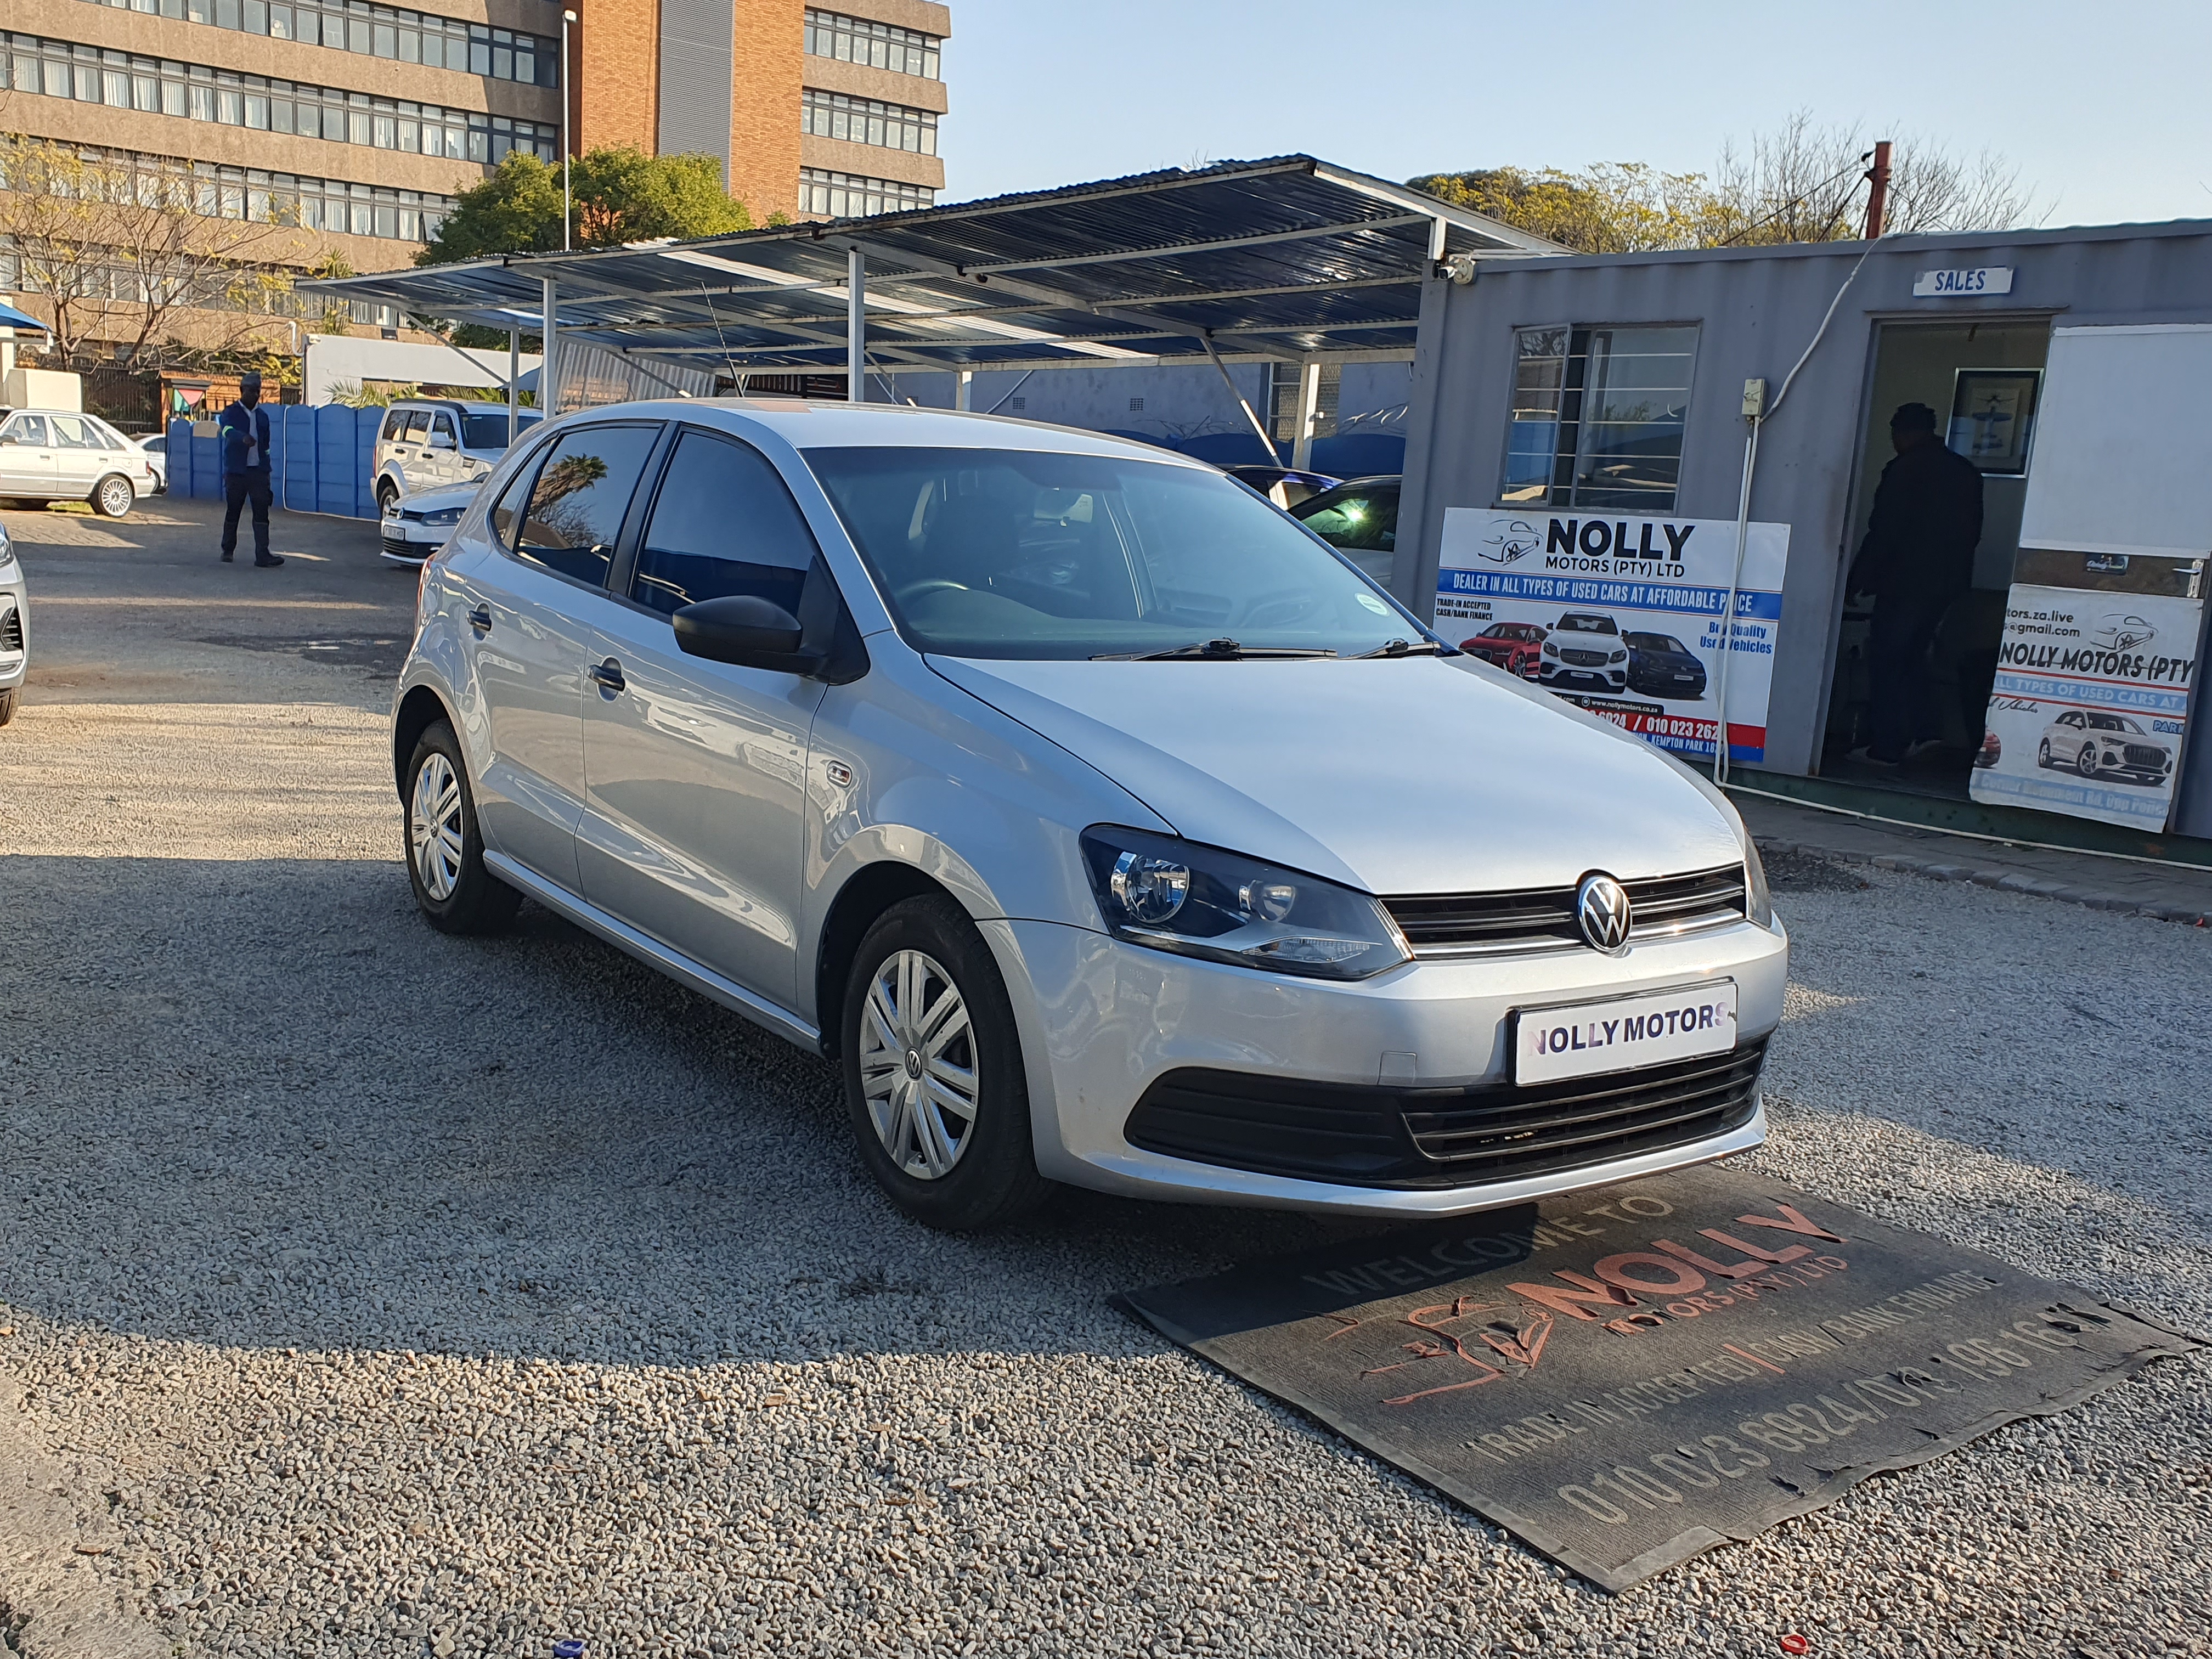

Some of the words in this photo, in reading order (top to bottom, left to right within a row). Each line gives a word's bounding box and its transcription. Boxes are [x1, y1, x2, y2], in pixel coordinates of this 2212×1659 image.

[1934, 270, 1986, 291] SALES
[1546, 518, 1696, 561] NOLLY
[1545, 556, 1609, 572] MOTORS
[1614, 559, 1652, 578] (PTY)
[1657, 563, 1685, 578] LTD
[1437, 598, 1462, 608] TRADE-IN
[1463, 600, 1491, 610] ACCEPTED
[1453, 573, 1487, 591] DEALER
[1489, 576, 1499, 592] IN
[1502, 577, 1519, 594] ALL
[1523, 578, 1553, 596] TYPES
[1556, 581, 1569, 597] OF
[1571, 582, 1598, 600] USED
[1600, 584, 1628, 602] CARS
[1630, 586, 1645, 603] AT
[1646, 588, 1716, 609] AFFORDABLE
[1719, 592, 1753, 612] PICE
[1436, 608, 1469, 619] CASH/BANK
[1470, 611, 1493, 620] FINANCE
[1731, 623, 1767, 639] Quality
[1999, 641, 2060, 668] NOLLY
[2061, 647, 2144, 678] MOTORS
[2016, 679, 2054, 693] TYPES
[2058, 684, 2076, 696] OF
[2079, 686, 2114, 701] USED
[2118, 691, 2156, 706] CARS
[2159, 696, 2179, 708] AT
[1646, 716, 1668, 734] 010
[1670, 720, 1694, 737] 023
[1695, 723, 1719, 740] 262
[1651, 734, 1683, 749] KEMPTON
[1685, 740, 1703, 752] PARK
[1527, 1019, 1620, 1056] NOLLY
[1623, 1001, 1729, 1042] MOTORS
[1301, 1216, 1607, 1295] WELCOME
[1582, 1196, 1674, 1224] TO
[1505, 1205, 1850, 1321] NOLLY
[1791, 1255, 1848, 1278] LTD
[1457, 1410, 1589, 1464] TRADE
[1563, 1398, 1623, 1426] IN
[1601, 1354, 1760, 1417] ACCEPTED
[1886, 1270, 2004, 1315] FINANCE
[1557, 1465, 1683, 1525] 010
[1649, 1434, 1771, 1487] 023
[1929, 1338, 2032, 1383] 196
